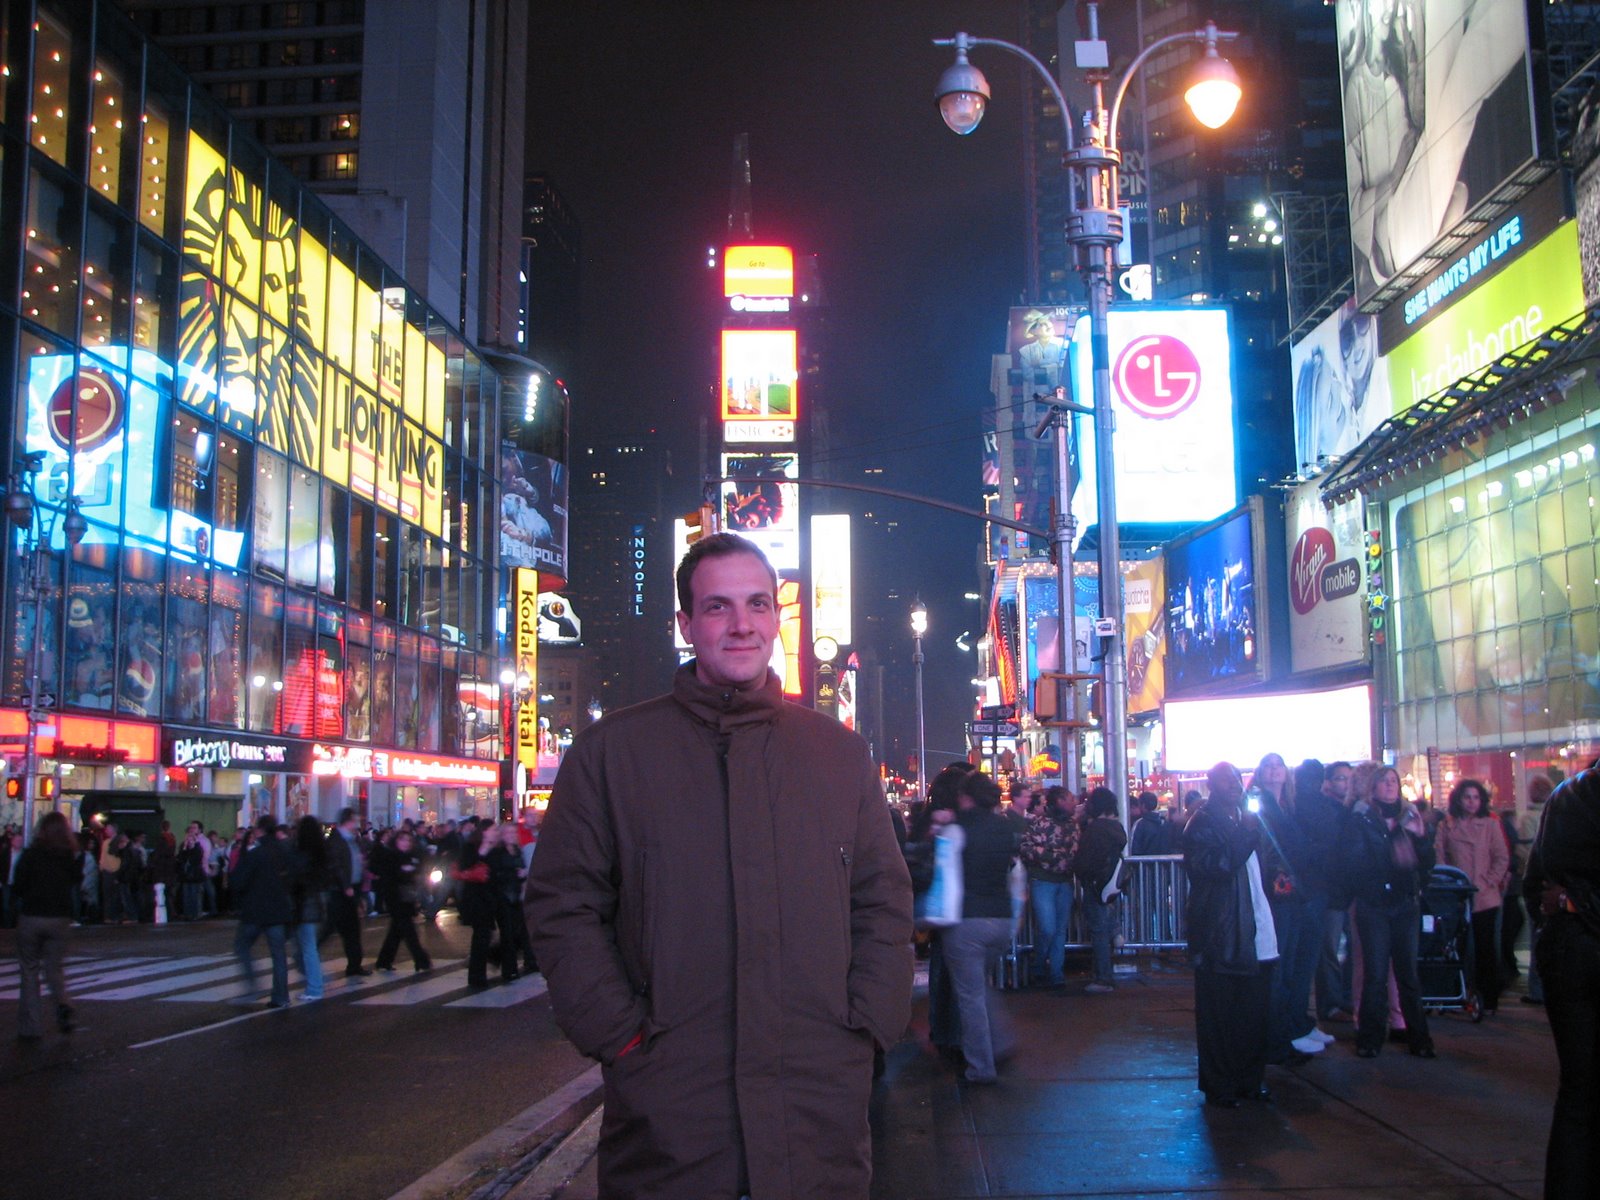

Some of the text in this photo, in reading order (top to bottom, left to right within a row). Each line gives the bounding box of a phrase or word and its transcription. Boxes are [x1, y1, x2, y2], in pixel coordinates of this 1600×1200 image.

[1404, 216, 1522, 325] SHE WANTS MY LIFE
[371, 330, 402, 388] THE
[332, 355, 436, 489] LION KING
[633, 537, 646, 616] NOVOTEL
[1294, 534, 1327, 604] Virgin
[1325, 564, 1356, 594] mobile
[520, 590, 535, 664] Kodak
